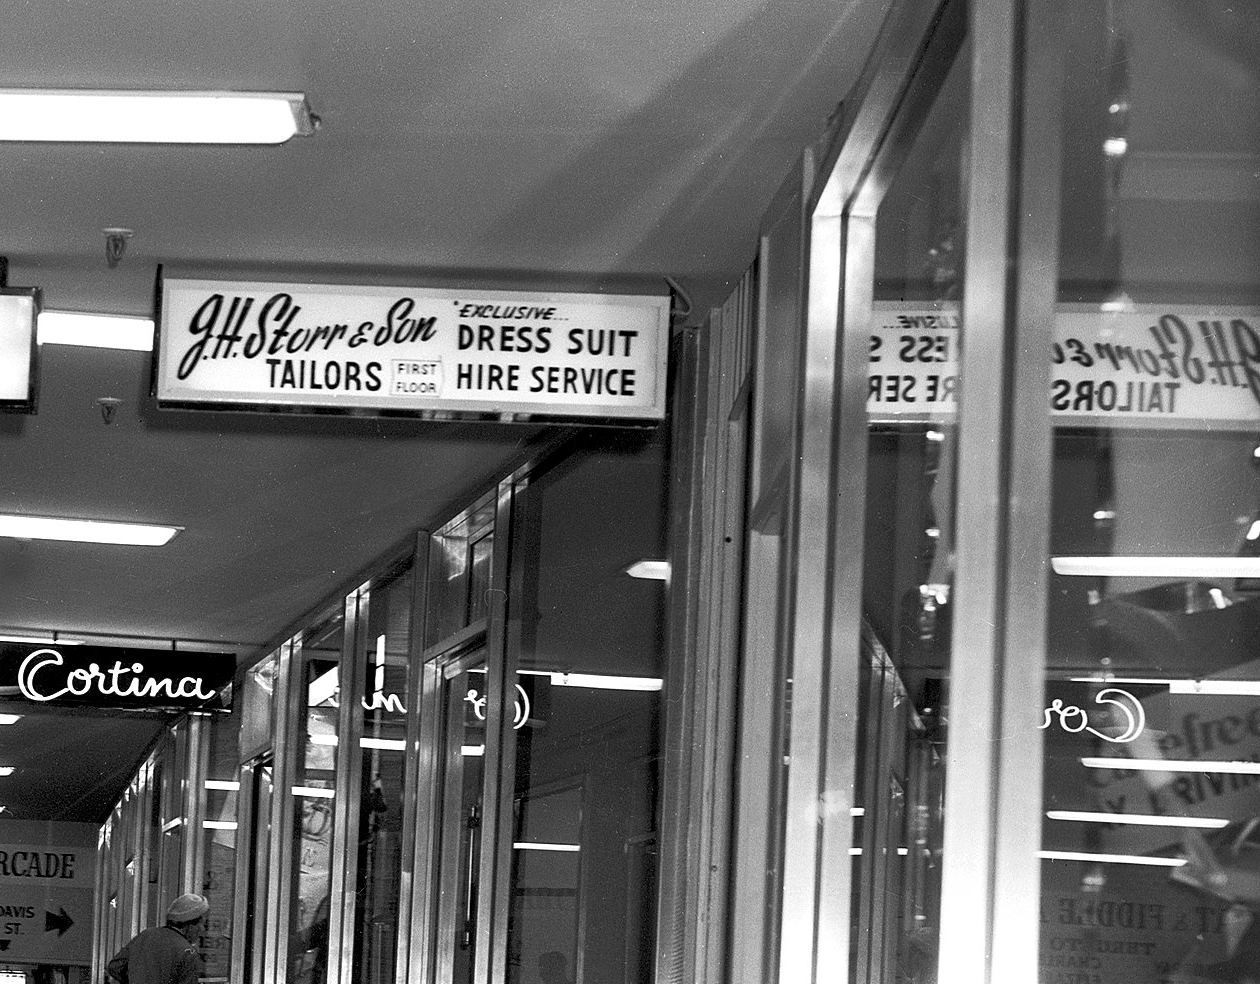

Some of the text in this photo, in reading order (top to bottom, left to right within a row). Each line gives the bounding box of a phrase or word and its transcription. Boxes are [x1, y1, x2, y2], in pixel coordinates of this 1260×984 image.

[242, 293, 348, 359] Storr
[347, 321, 374, 348] &
[373, 296, 438, 346] Son
[457, 324, 639, 357] DRESS SUIT
[265, 357, 382, 392] TAILORS
[397, 362, 437, 375] FIRST
[456, 363, 636, 397] HIRE SERVICE
[396, 381, 437, 393] FLOOR
[17, 648, 216, 701] Cortina
